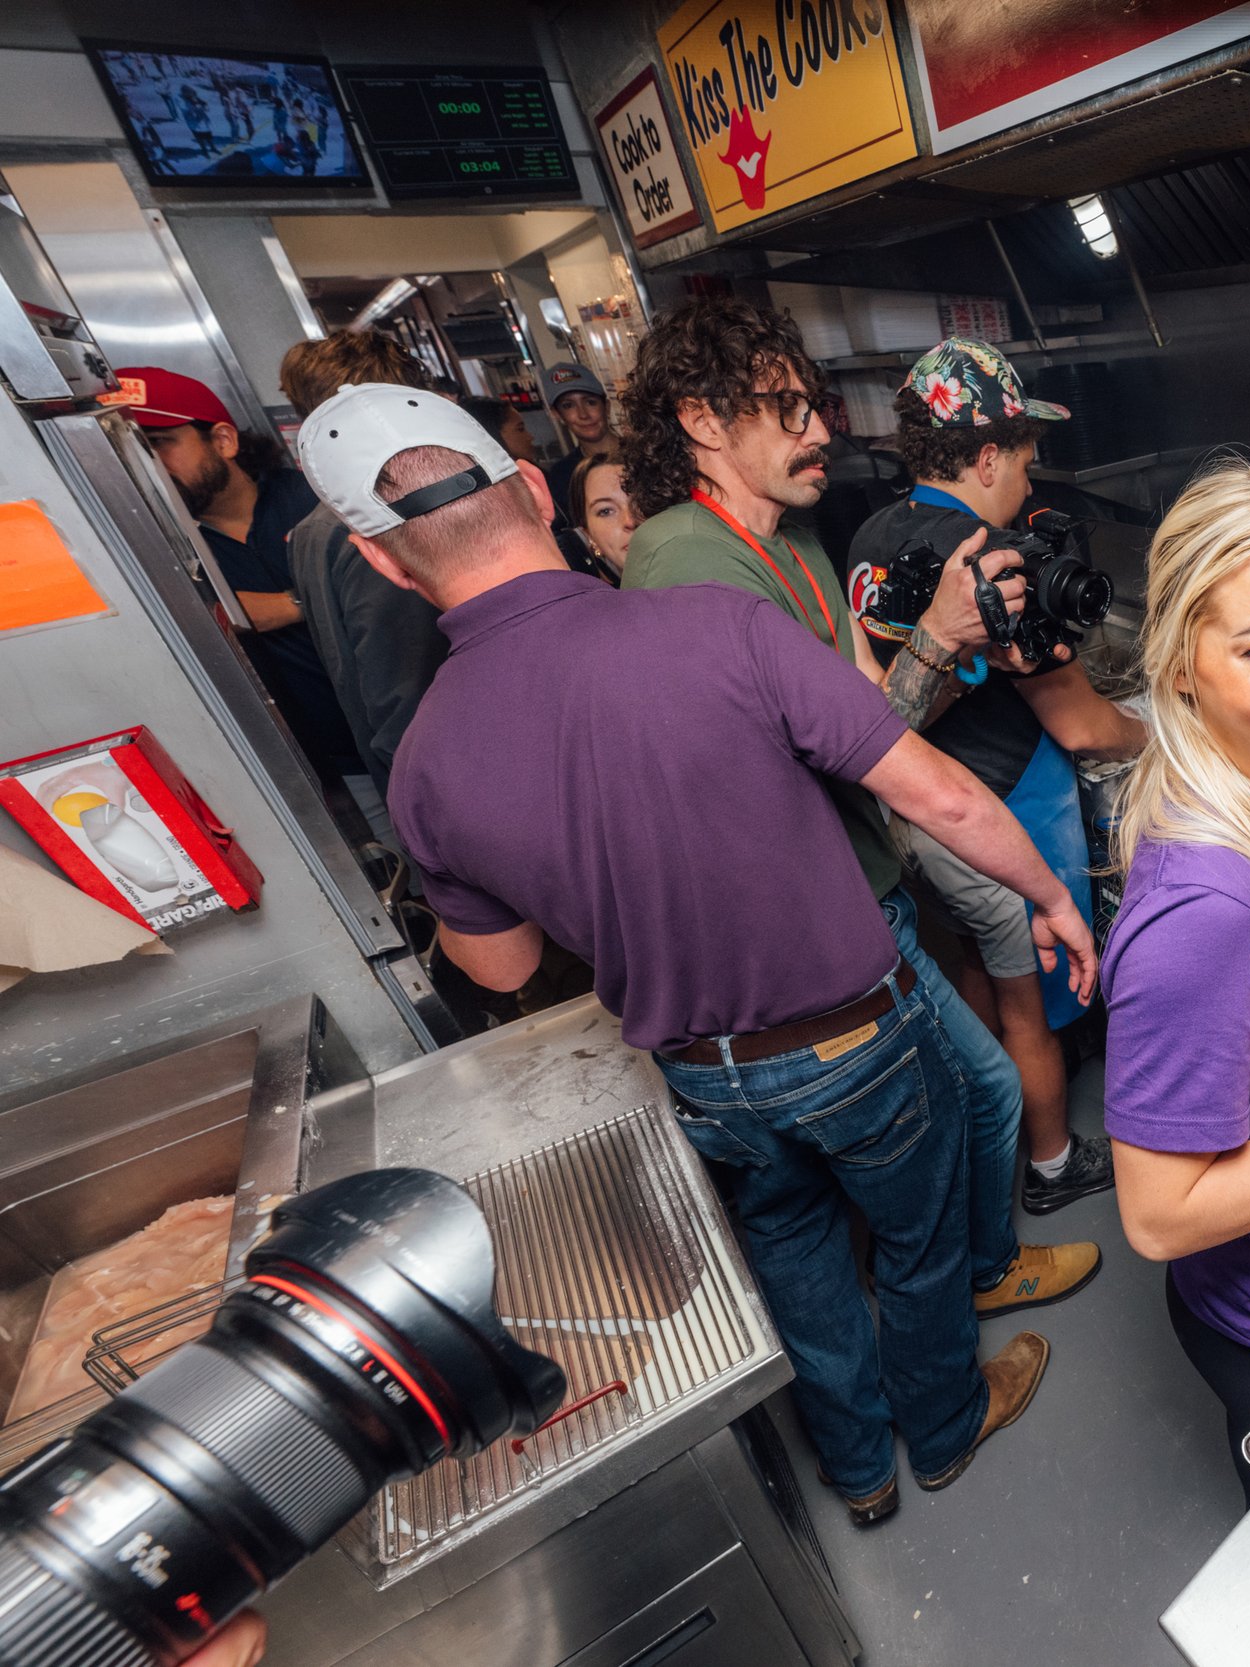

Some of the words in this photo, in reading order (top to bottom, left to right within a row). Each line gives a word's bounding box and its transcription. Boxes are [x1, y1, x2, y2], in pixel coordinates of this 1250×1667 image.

[675, 56, 730, 149] Kiss
[719, 17, 776, 115] The
[438, 102, 481, 114] 00:00
[611, 112, 650, 174] Cook
[639, 114, 661, 156] to
[460, 161, 501, 173] 03:04
[633, 165, 674, 223] Order
[866, 620, 888, 634] CHICKEN
[383, 1379, 409, 1405] USM
